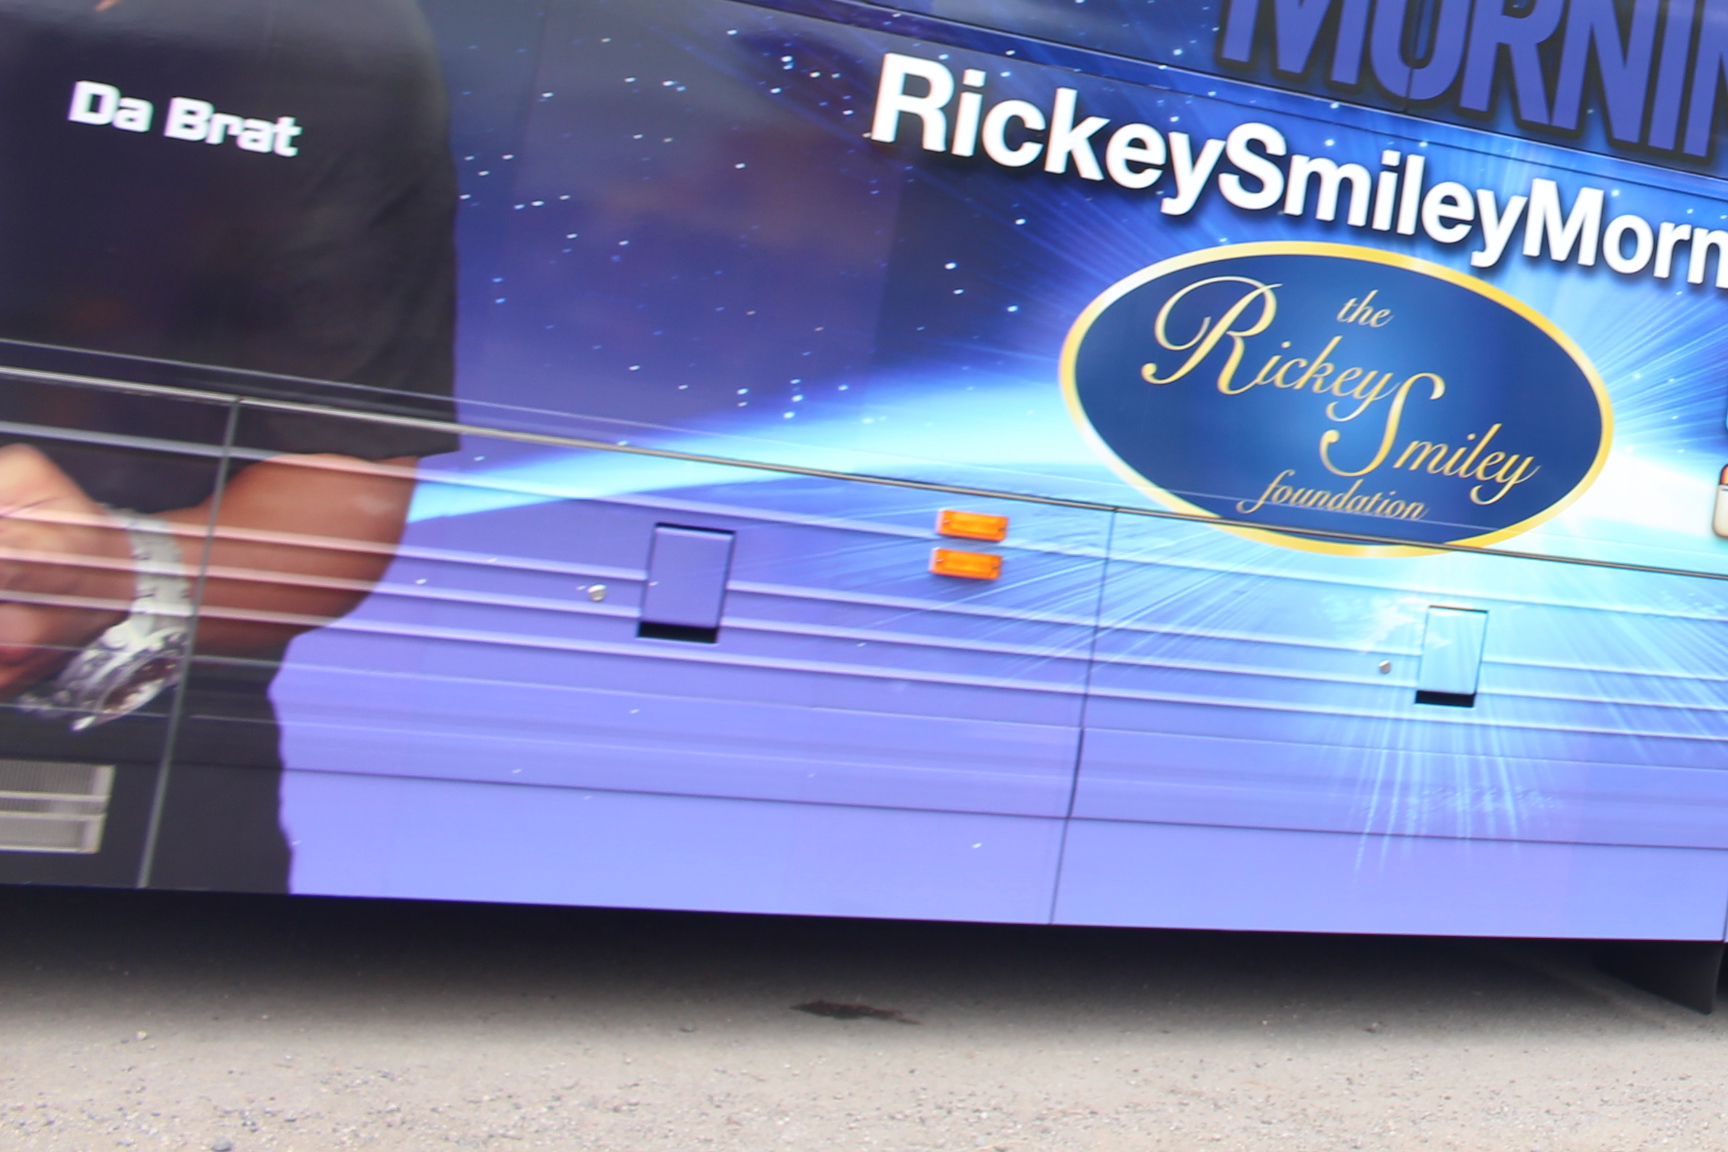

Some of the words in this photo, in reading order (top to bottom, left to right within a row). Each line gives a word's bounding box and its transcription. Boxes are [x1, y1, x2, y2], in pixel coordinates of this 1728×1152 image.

[68, 80, 153, 133] Da
[164, 96, 302, 157] Brat
[1336, 289, 1394, 328] the
[1141, 276, 1404, 422] Rickey
[1320, 373, 1541, 505] Smiley
[1236, 470, 1429, 522] foundation
